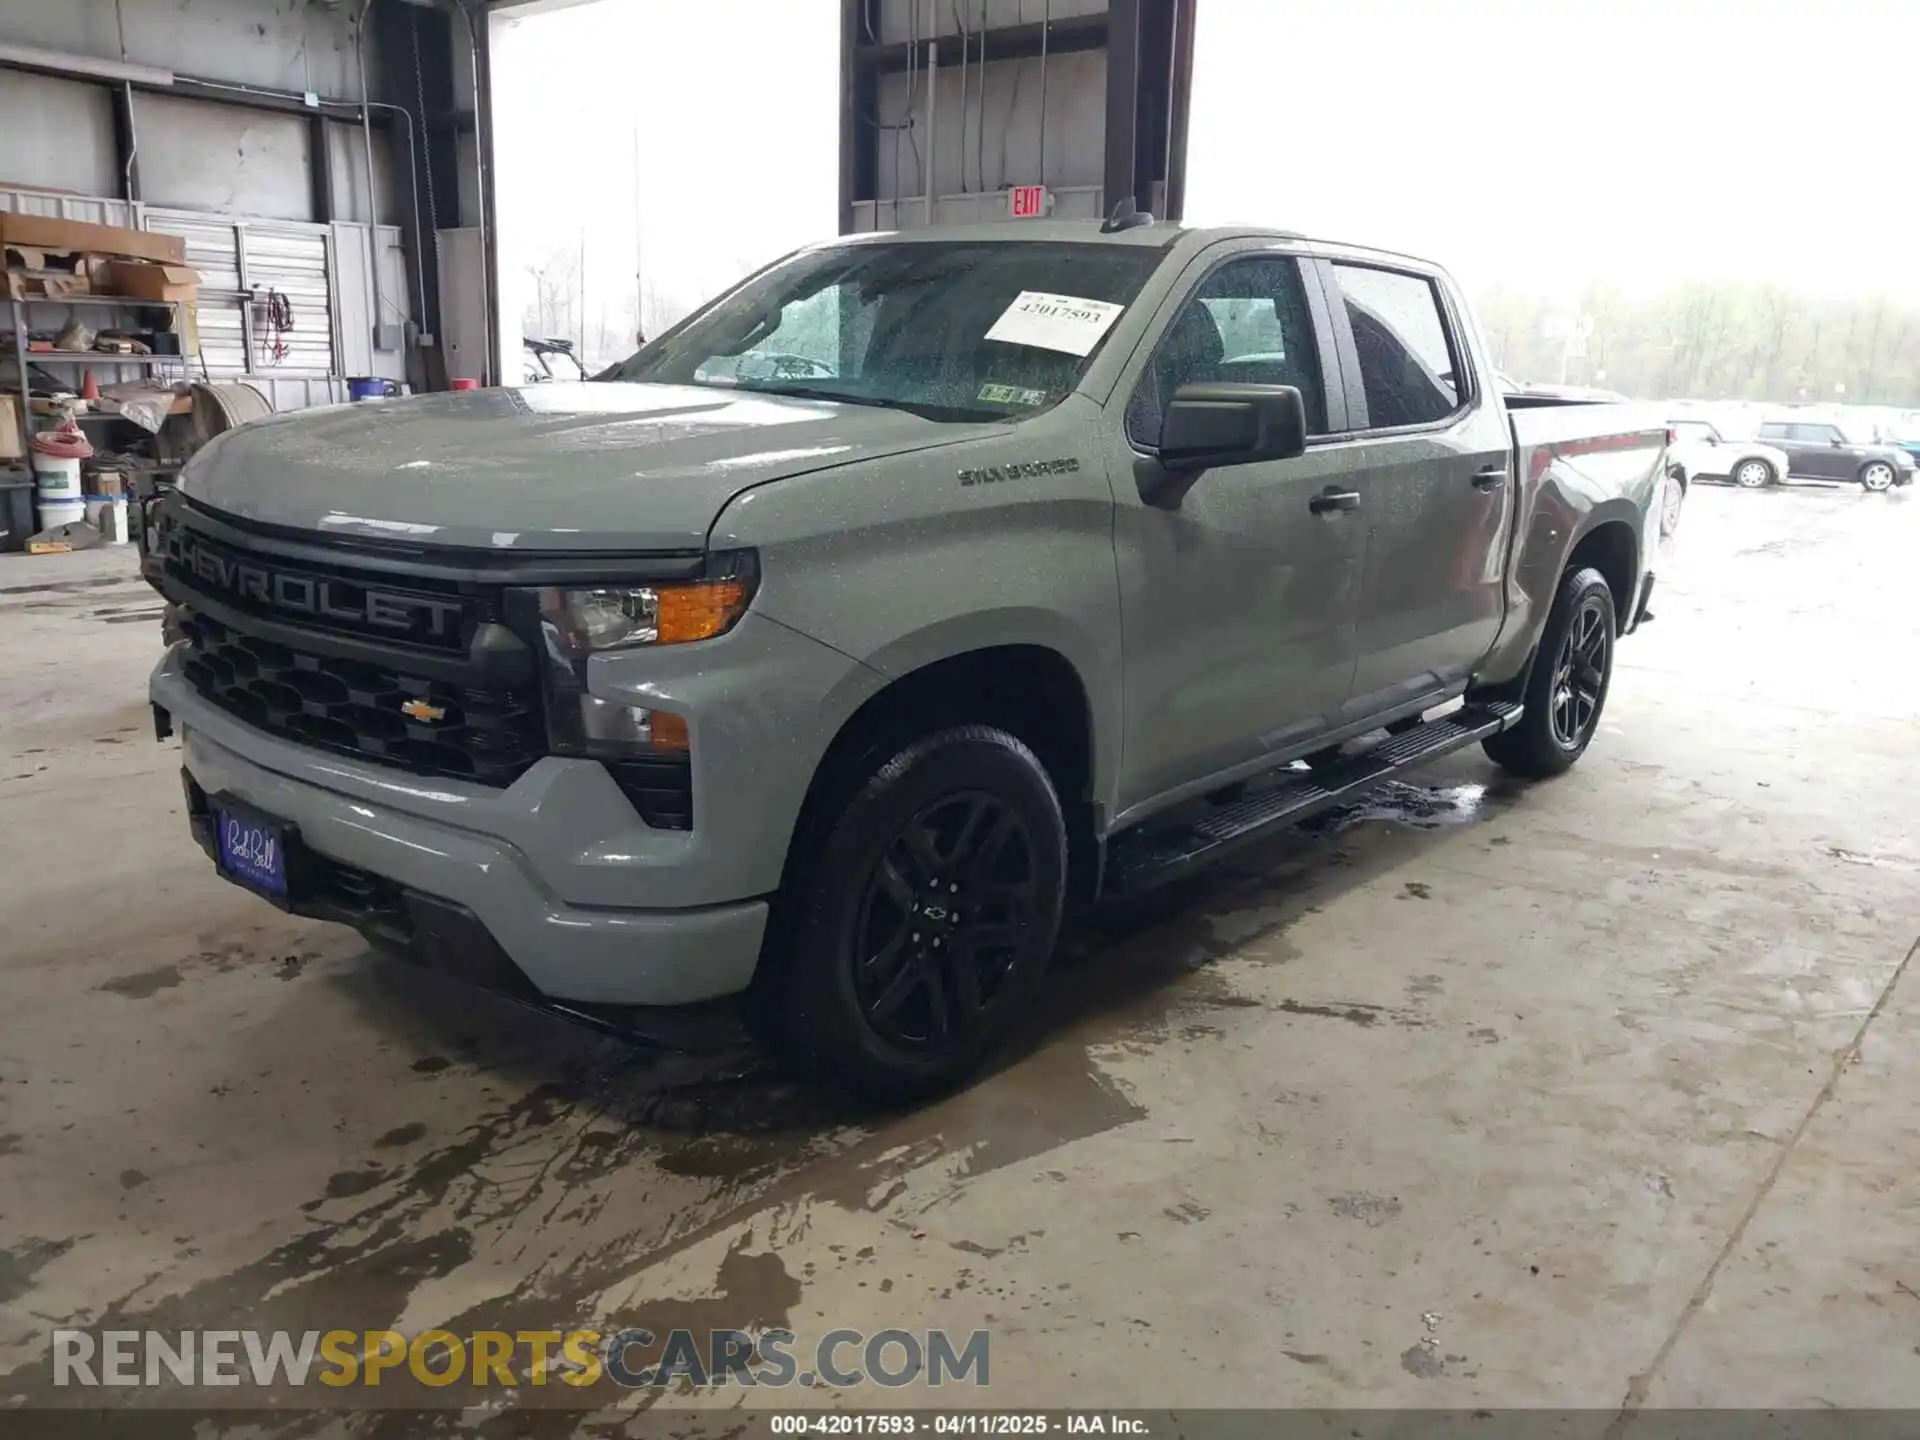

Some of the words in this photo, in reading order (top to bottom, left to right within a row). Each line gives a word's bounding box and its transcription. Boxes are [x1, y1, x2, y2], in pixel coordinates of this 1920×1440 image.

[1014, 187, 1041, 216] EXIT
[1019, 302, 1102, 324] 42017593
[166, 528, 462, 635] CHEVROLET
